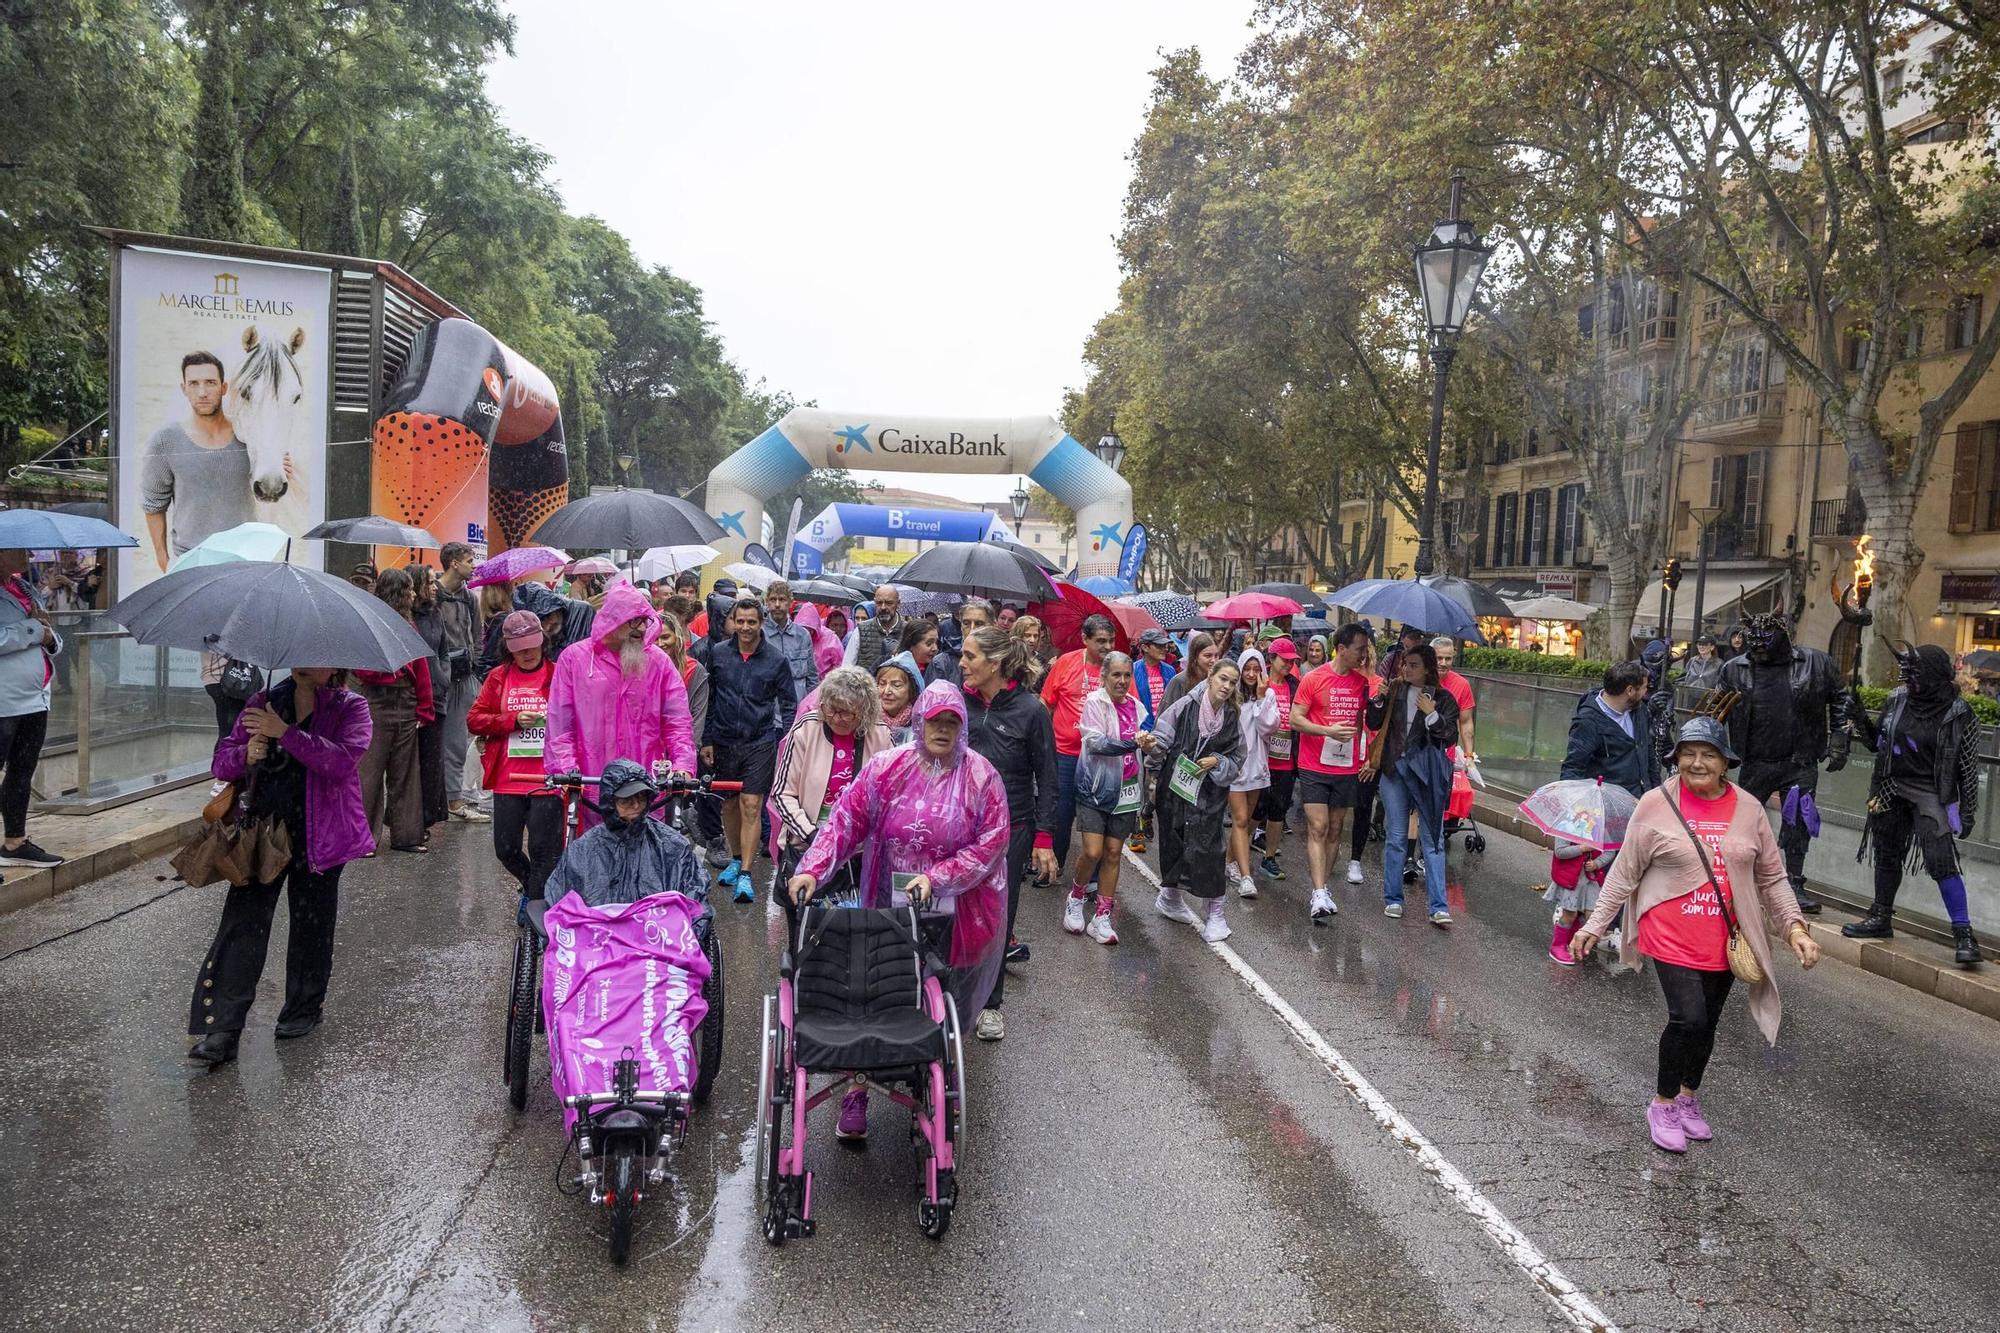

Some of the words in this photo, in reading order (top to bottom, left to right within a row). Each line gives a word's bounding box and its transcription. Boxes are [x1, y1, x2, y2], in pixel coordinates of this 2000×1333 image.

[158, 292, 230, 311] MARCEL
[235, 298, 294, 316] REMUS
[223, 313, 258, 321] ESTATE
[878, 428, 1007, 456] CaixaBank
[906, 520, 940, 531] travel
[811, 536, 834, 544] travel
[1125, 531, 1144, 578] SAMPOL
[1539, 574, 1571, 582] RE/MAX
[508, 696, 519, 704] En
[508, 703, 538, 711] contra
[518, 727, 545, 739] 3506
